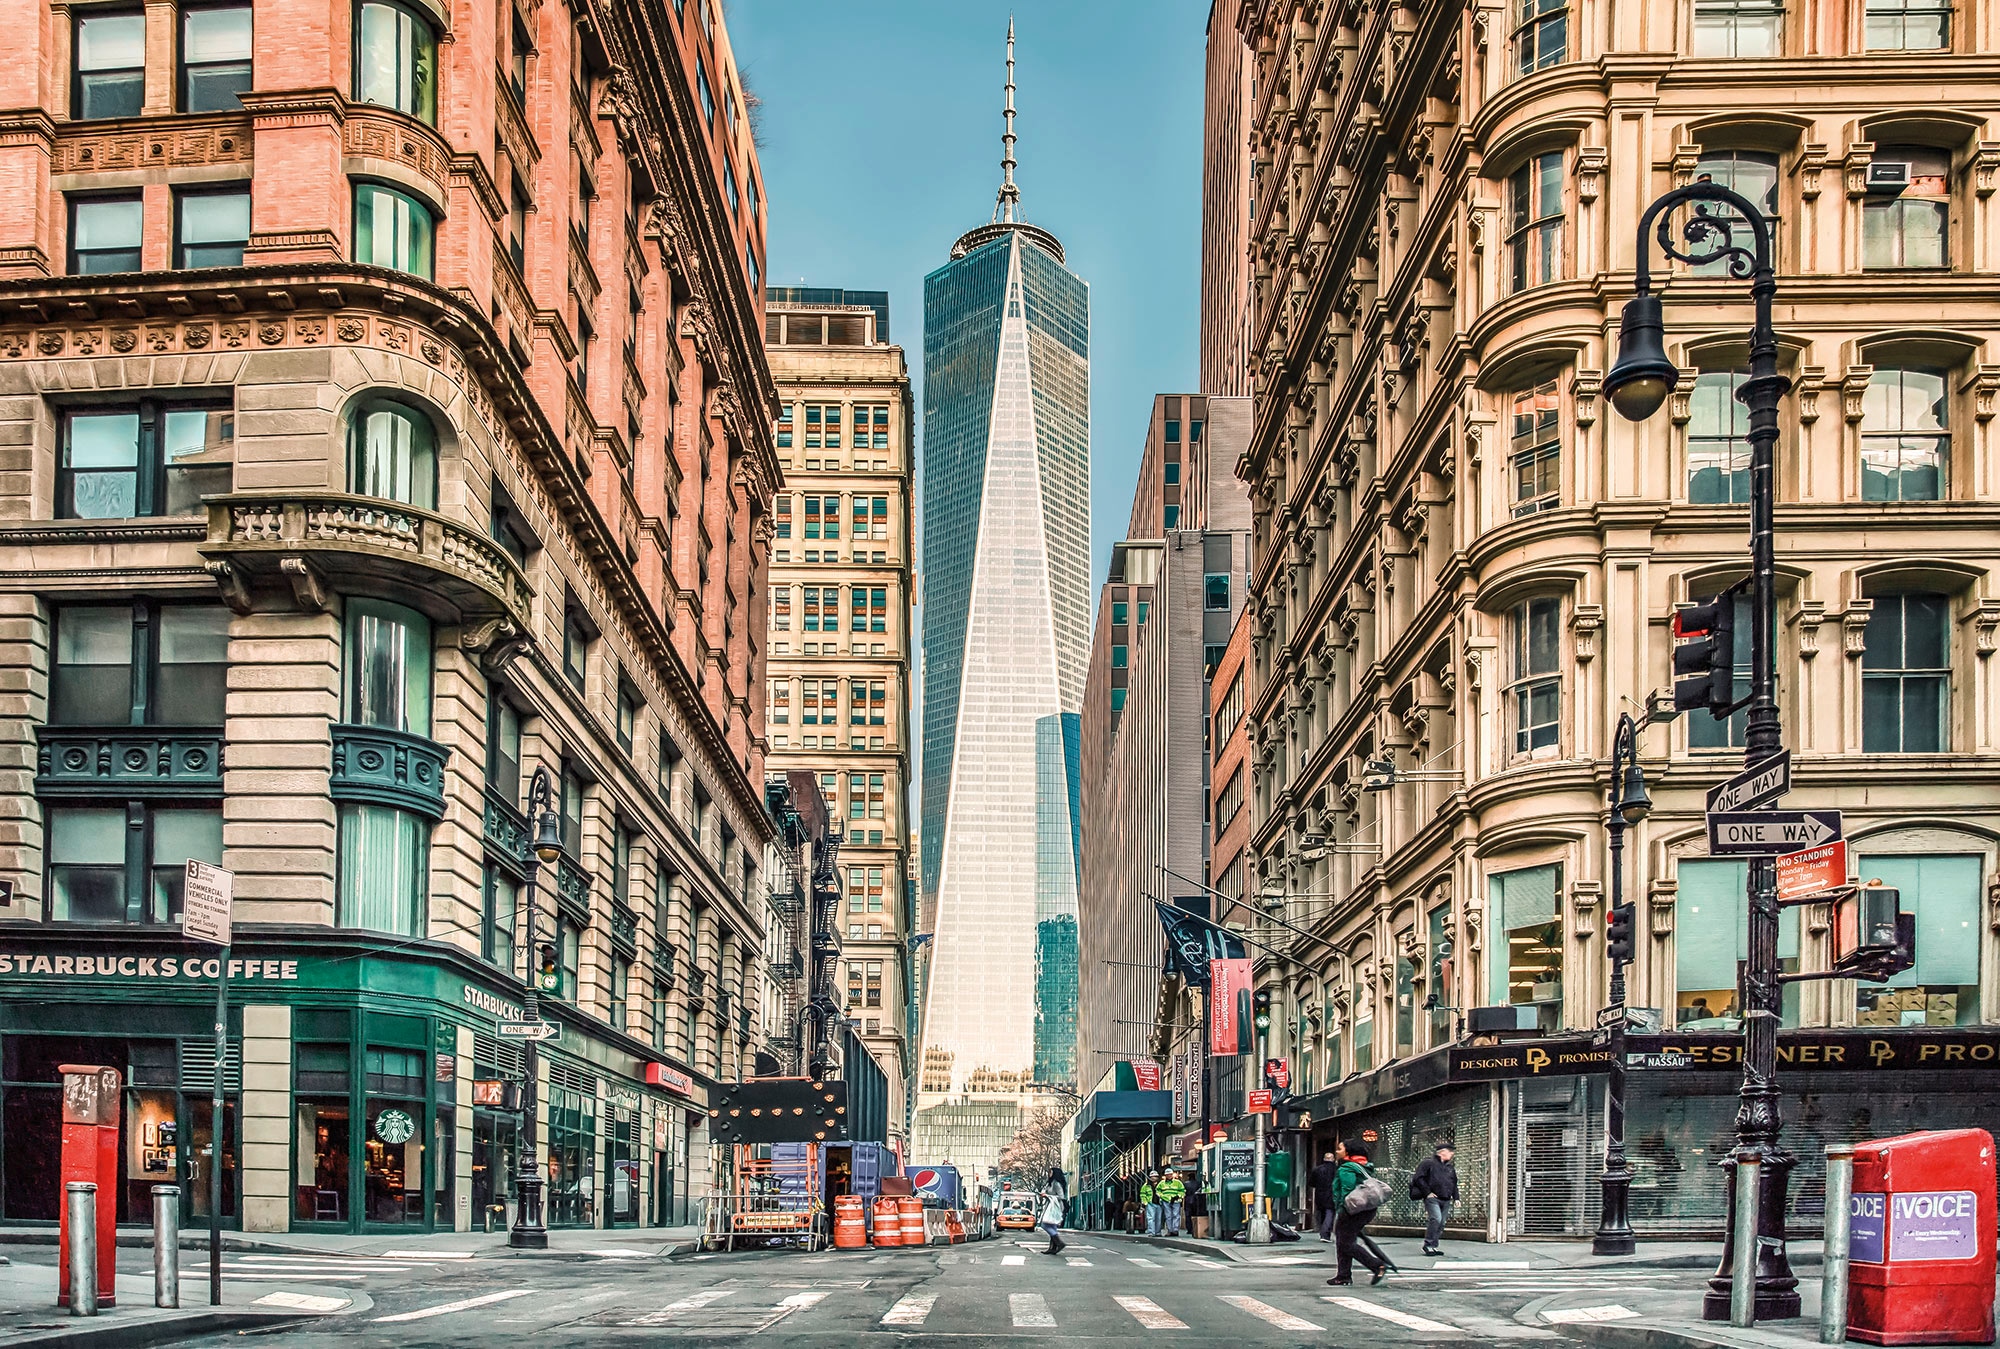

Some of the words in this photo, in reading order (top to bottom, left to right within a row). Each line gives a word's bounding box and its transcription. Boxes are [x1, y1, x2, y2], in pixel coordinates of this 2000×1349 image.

[1717, 788, 1741, 812] ONE
[1752, 769, 1778, 796] WAY
[1728, 826, 1765, 842] ONE
[1783, 824, 1822, 841] WAY
[1780, 858, 1791, 867] NO
[1793, 847, 1834, 865] STANDING
[189, 862, 198, 878] 3
[1780, 866, 1805, 877] Monday
[1810, 860, 1829, 870] Friday
[1799, 873, 1813, 881] 7pm
[189, 882, 223, 897] COMMERCIAL
[189, 889, 214, 903] VEHICLES
[215, 898, 228, 906] ONLY
[187, 916, 202, 926] Except
[203, 920, 218, 930] Sunday
[0, 954, 178, 977] STARBUCKS
[183, 958, 298, 979] COFFEE
[464, 985, 520, 1021] STARBUCKS
[505, 1026, 525, 1034] ONE
[1460, 1057, 1518, 1070] DESIGNER
[1559, 1051, 1611, 1064] PROMISE
[1919, 1044, 2000, 1061] PRO
[1648, 1057, 1685, 1067] NASSAU
[1850, 1197, 1883, 1218] OICE
[1900, 1195, 1972, 1219] VOICE
